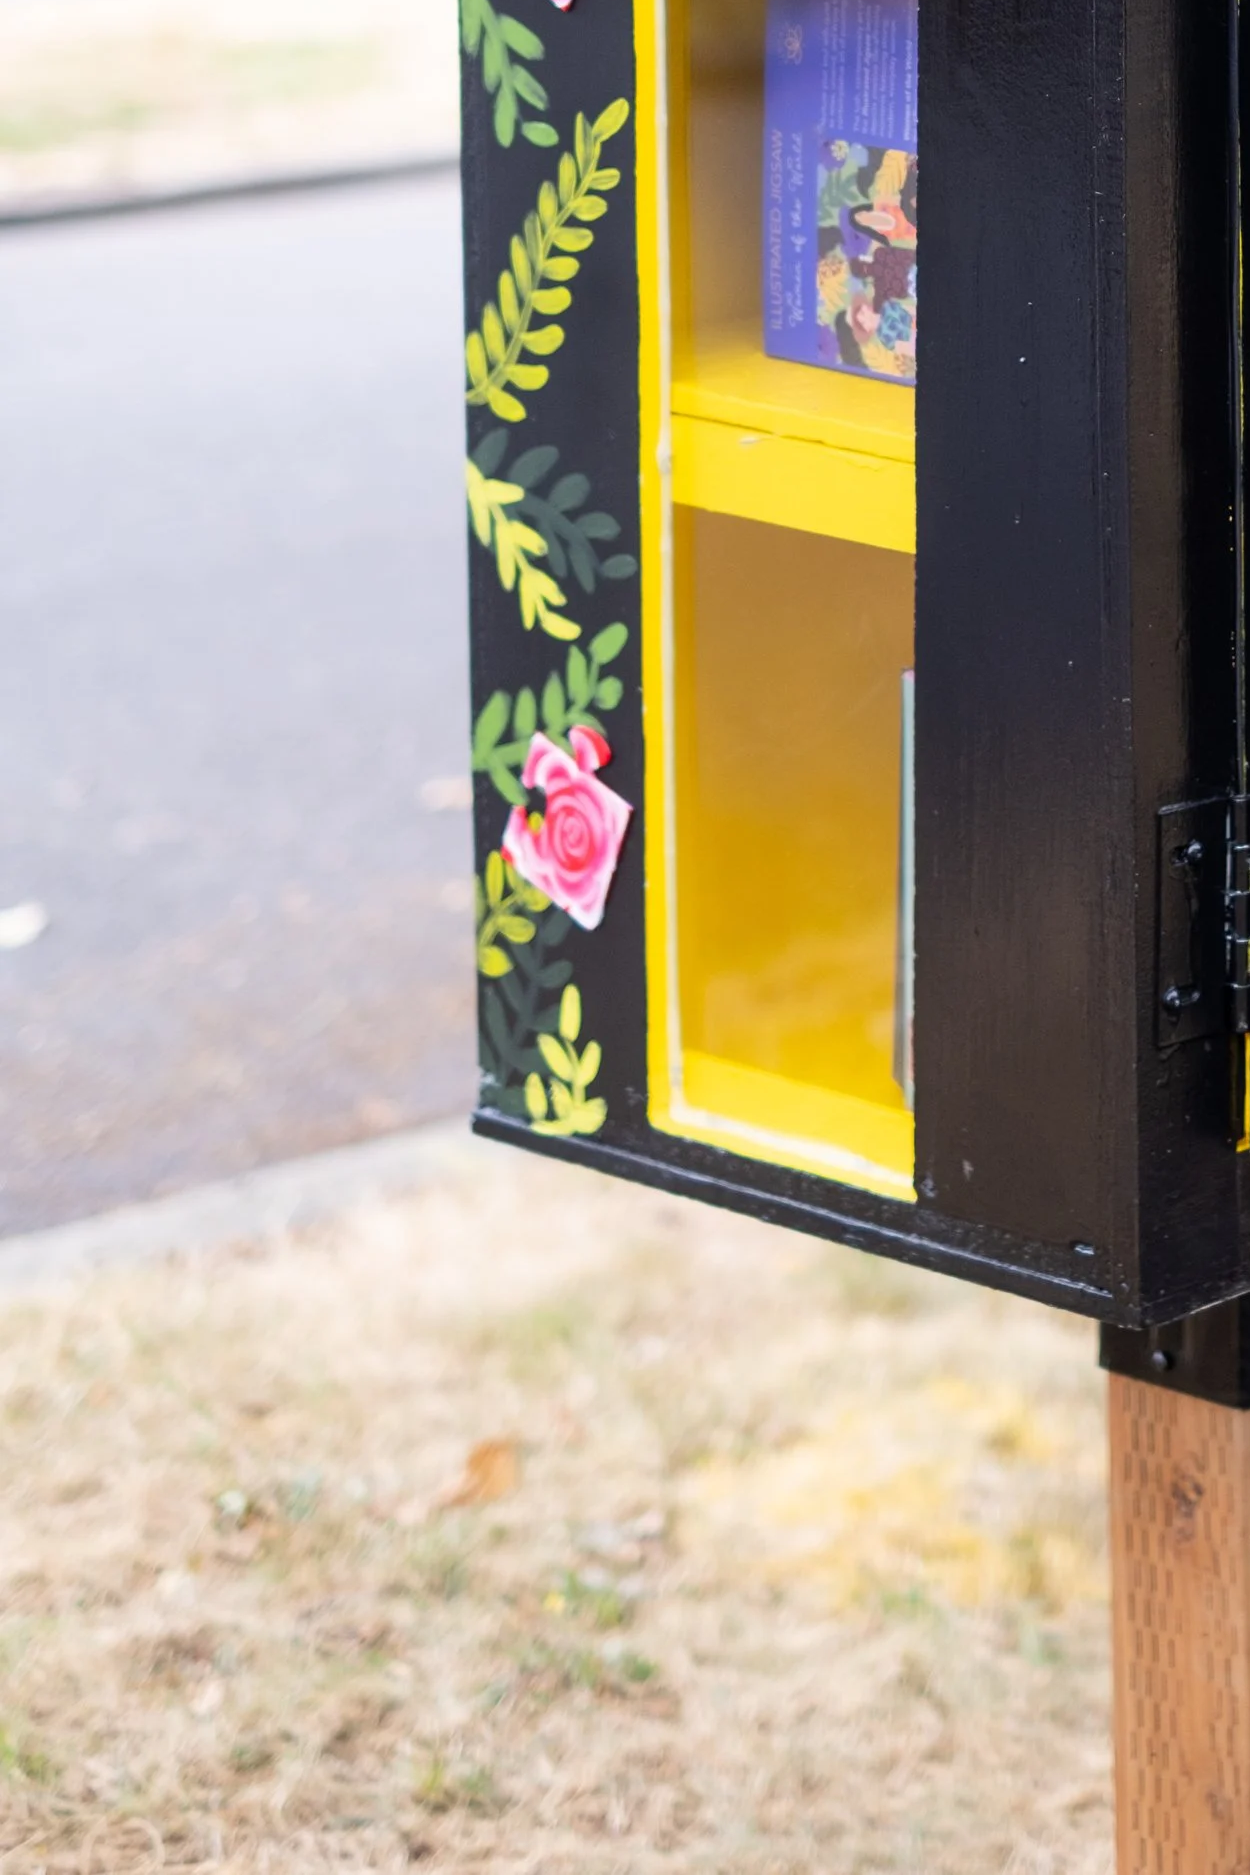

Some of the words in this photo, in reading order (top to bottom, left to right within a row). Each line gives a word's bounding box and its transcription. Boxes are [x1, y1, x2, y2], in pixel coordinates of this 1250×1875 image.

[770, 128, 785, 204] JIGSAW
[768, 207, 784, 331] ILLUSTRATED
[790, 233, 808, 253] of
